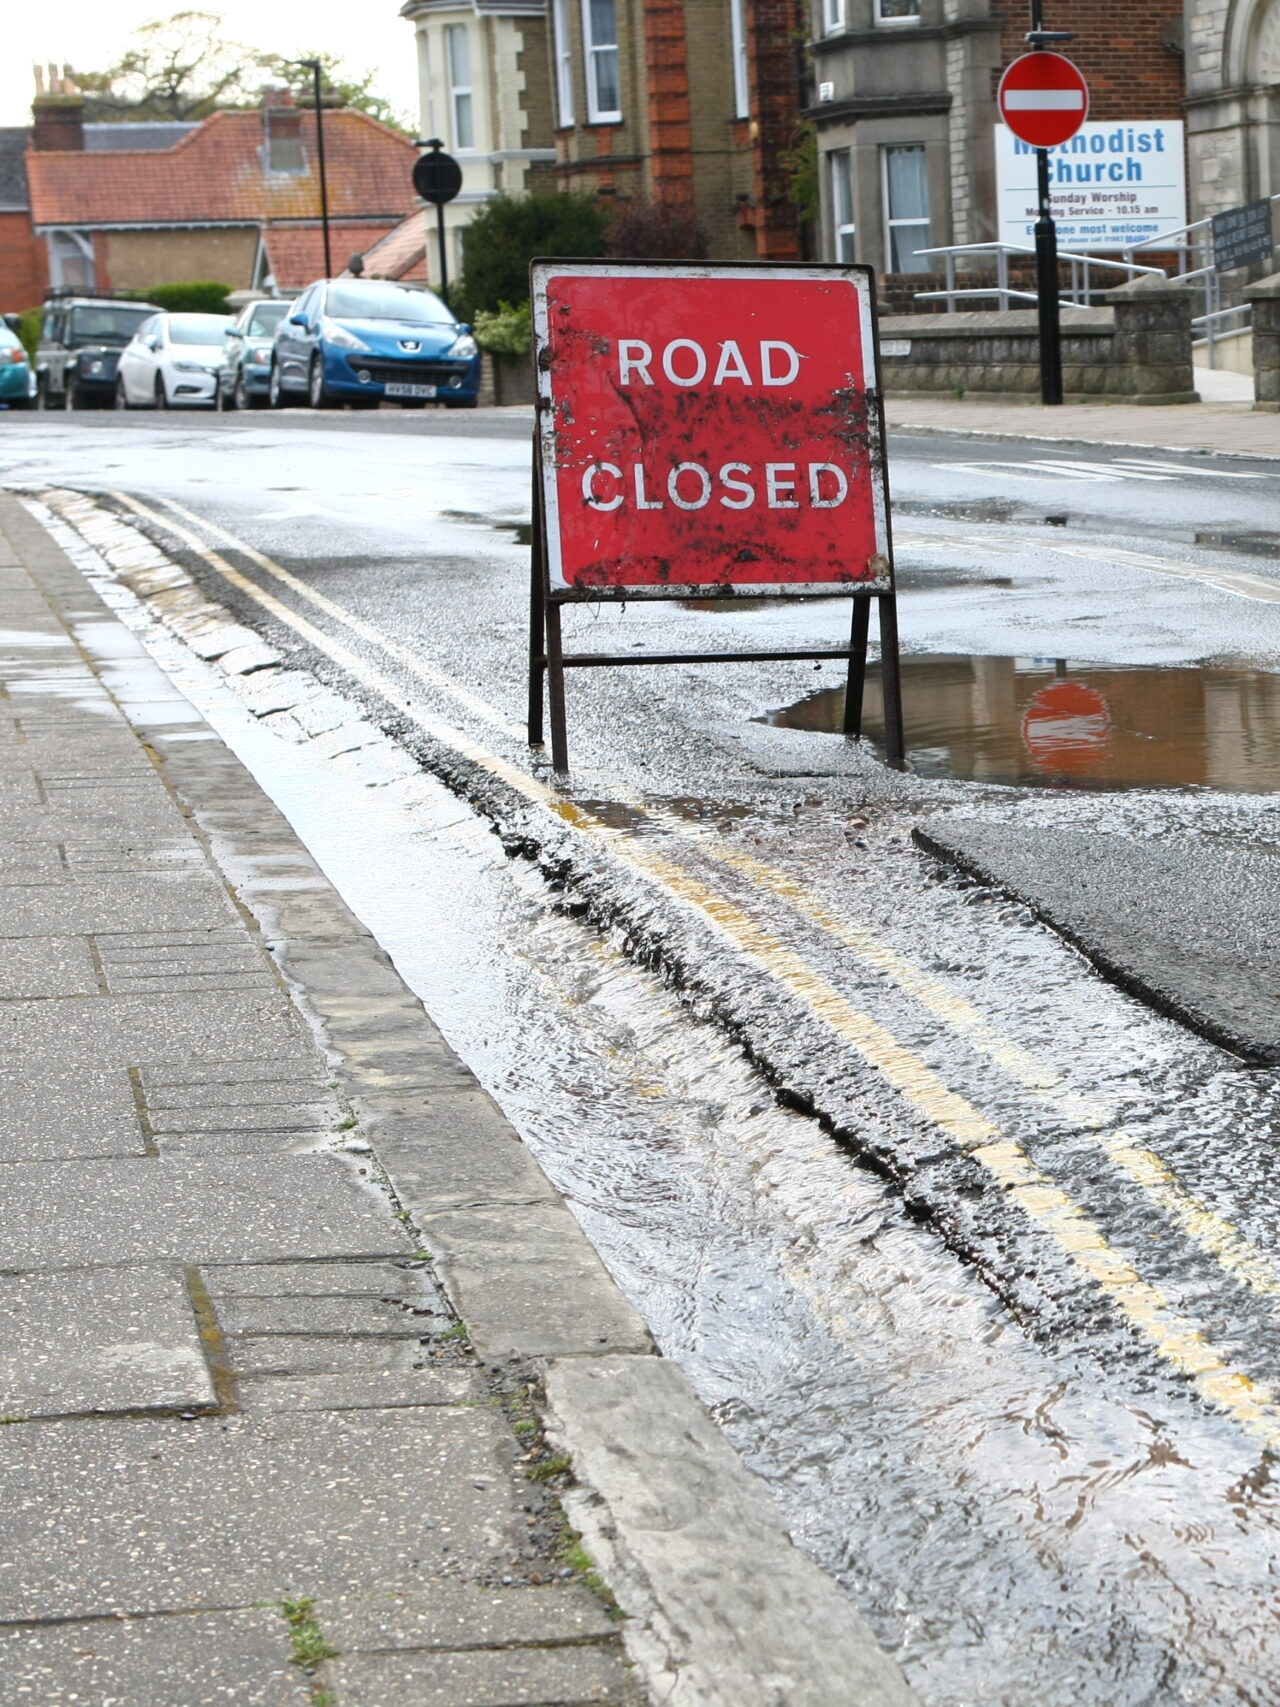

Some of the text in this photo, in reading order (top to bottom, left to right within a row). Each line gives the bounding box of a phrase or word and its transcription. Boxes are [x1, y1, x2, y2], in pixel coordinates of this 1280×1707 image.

[1091, 192, 1137, 204] Worship
[1025, 207, 1065, 218] Moing
[1068, 206, 1104, 216] Service
[1116, 205, 1140, 214] 10.15
[1144, 206, 1159, 214] am
[1080, 224, 1106, 234] most
[1111, 223, 1159, 233] welcome
[618, 338, 801, 387] ROAD
[581, 461, 849, 512] CLOSED
